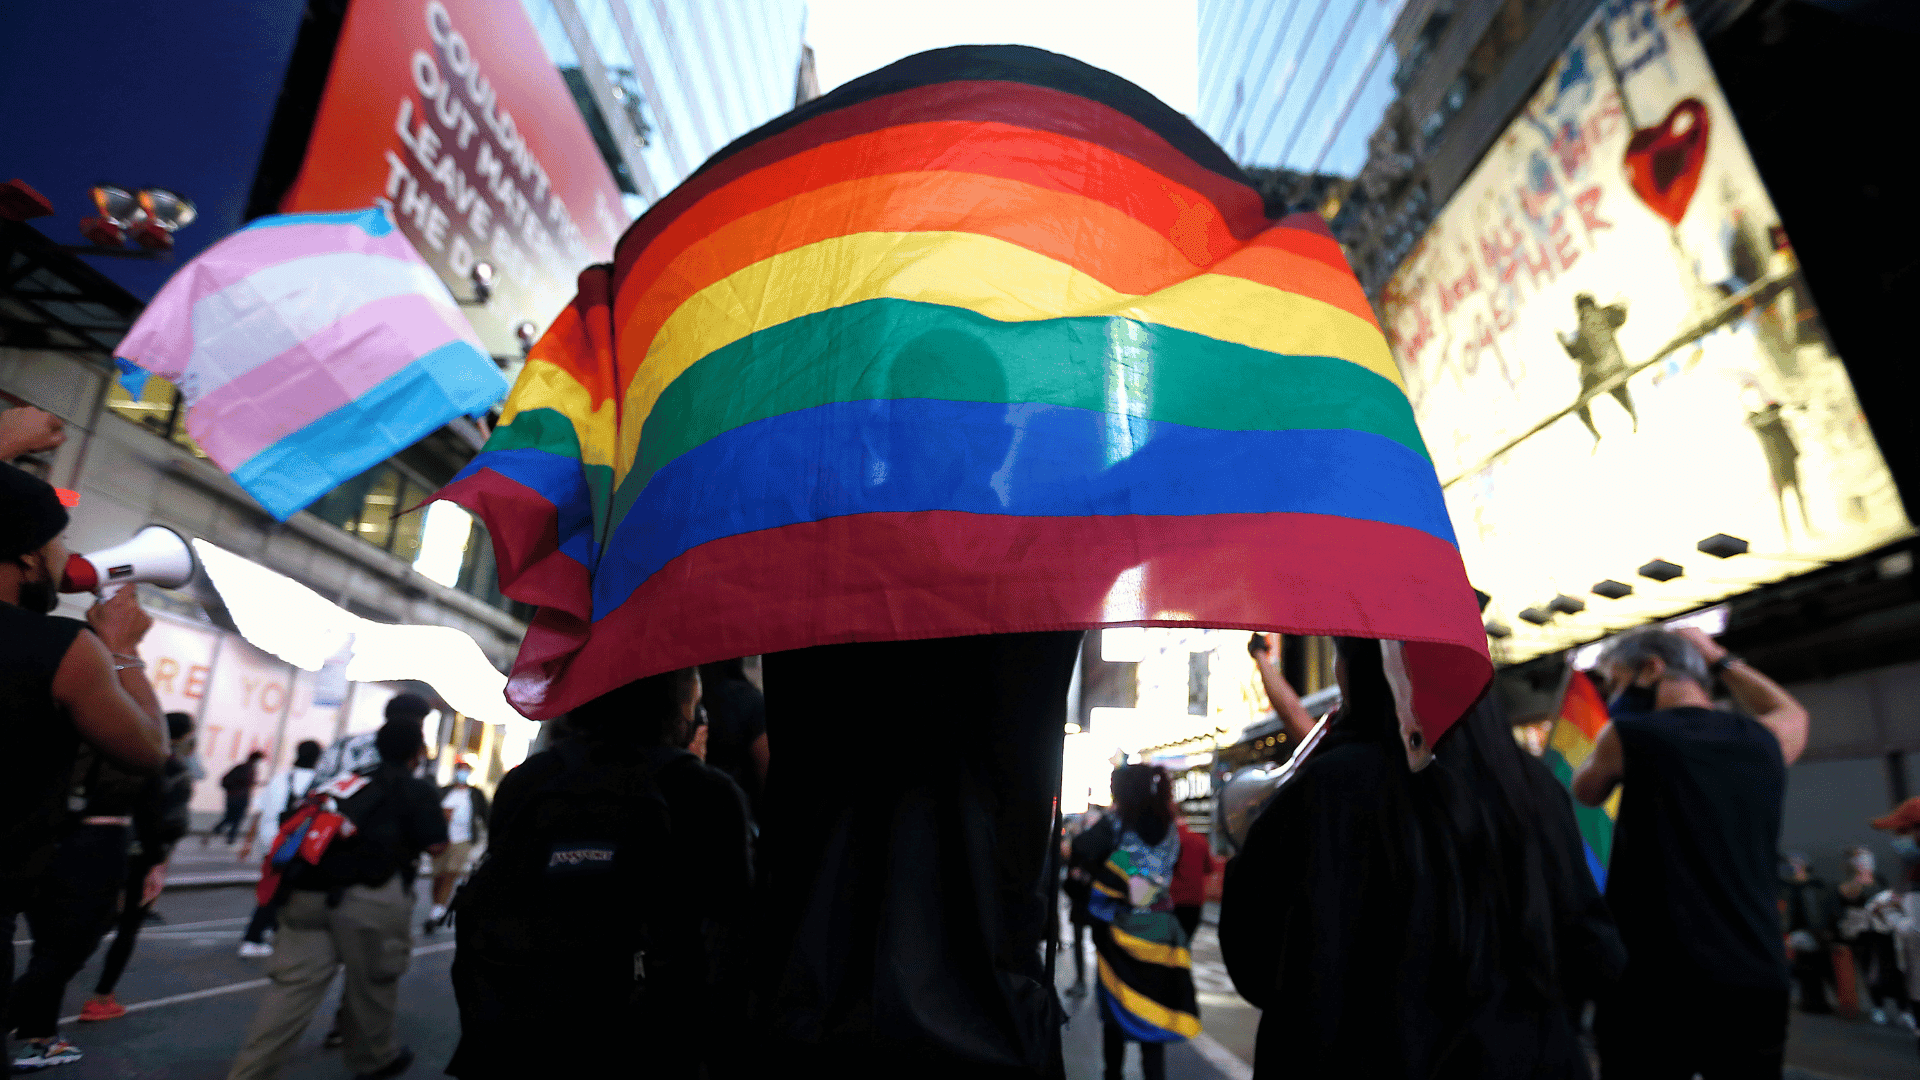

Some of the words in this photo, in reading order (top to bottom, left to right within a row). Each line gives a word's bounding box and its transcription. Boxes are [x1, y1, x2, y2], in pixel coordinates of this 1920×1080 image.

[411, 50, 479, 150] OUT
[384, 150, 450, 252] THE
[396, 96, 494, 242] LEAVE
[152, 657, 210, 700] RE
